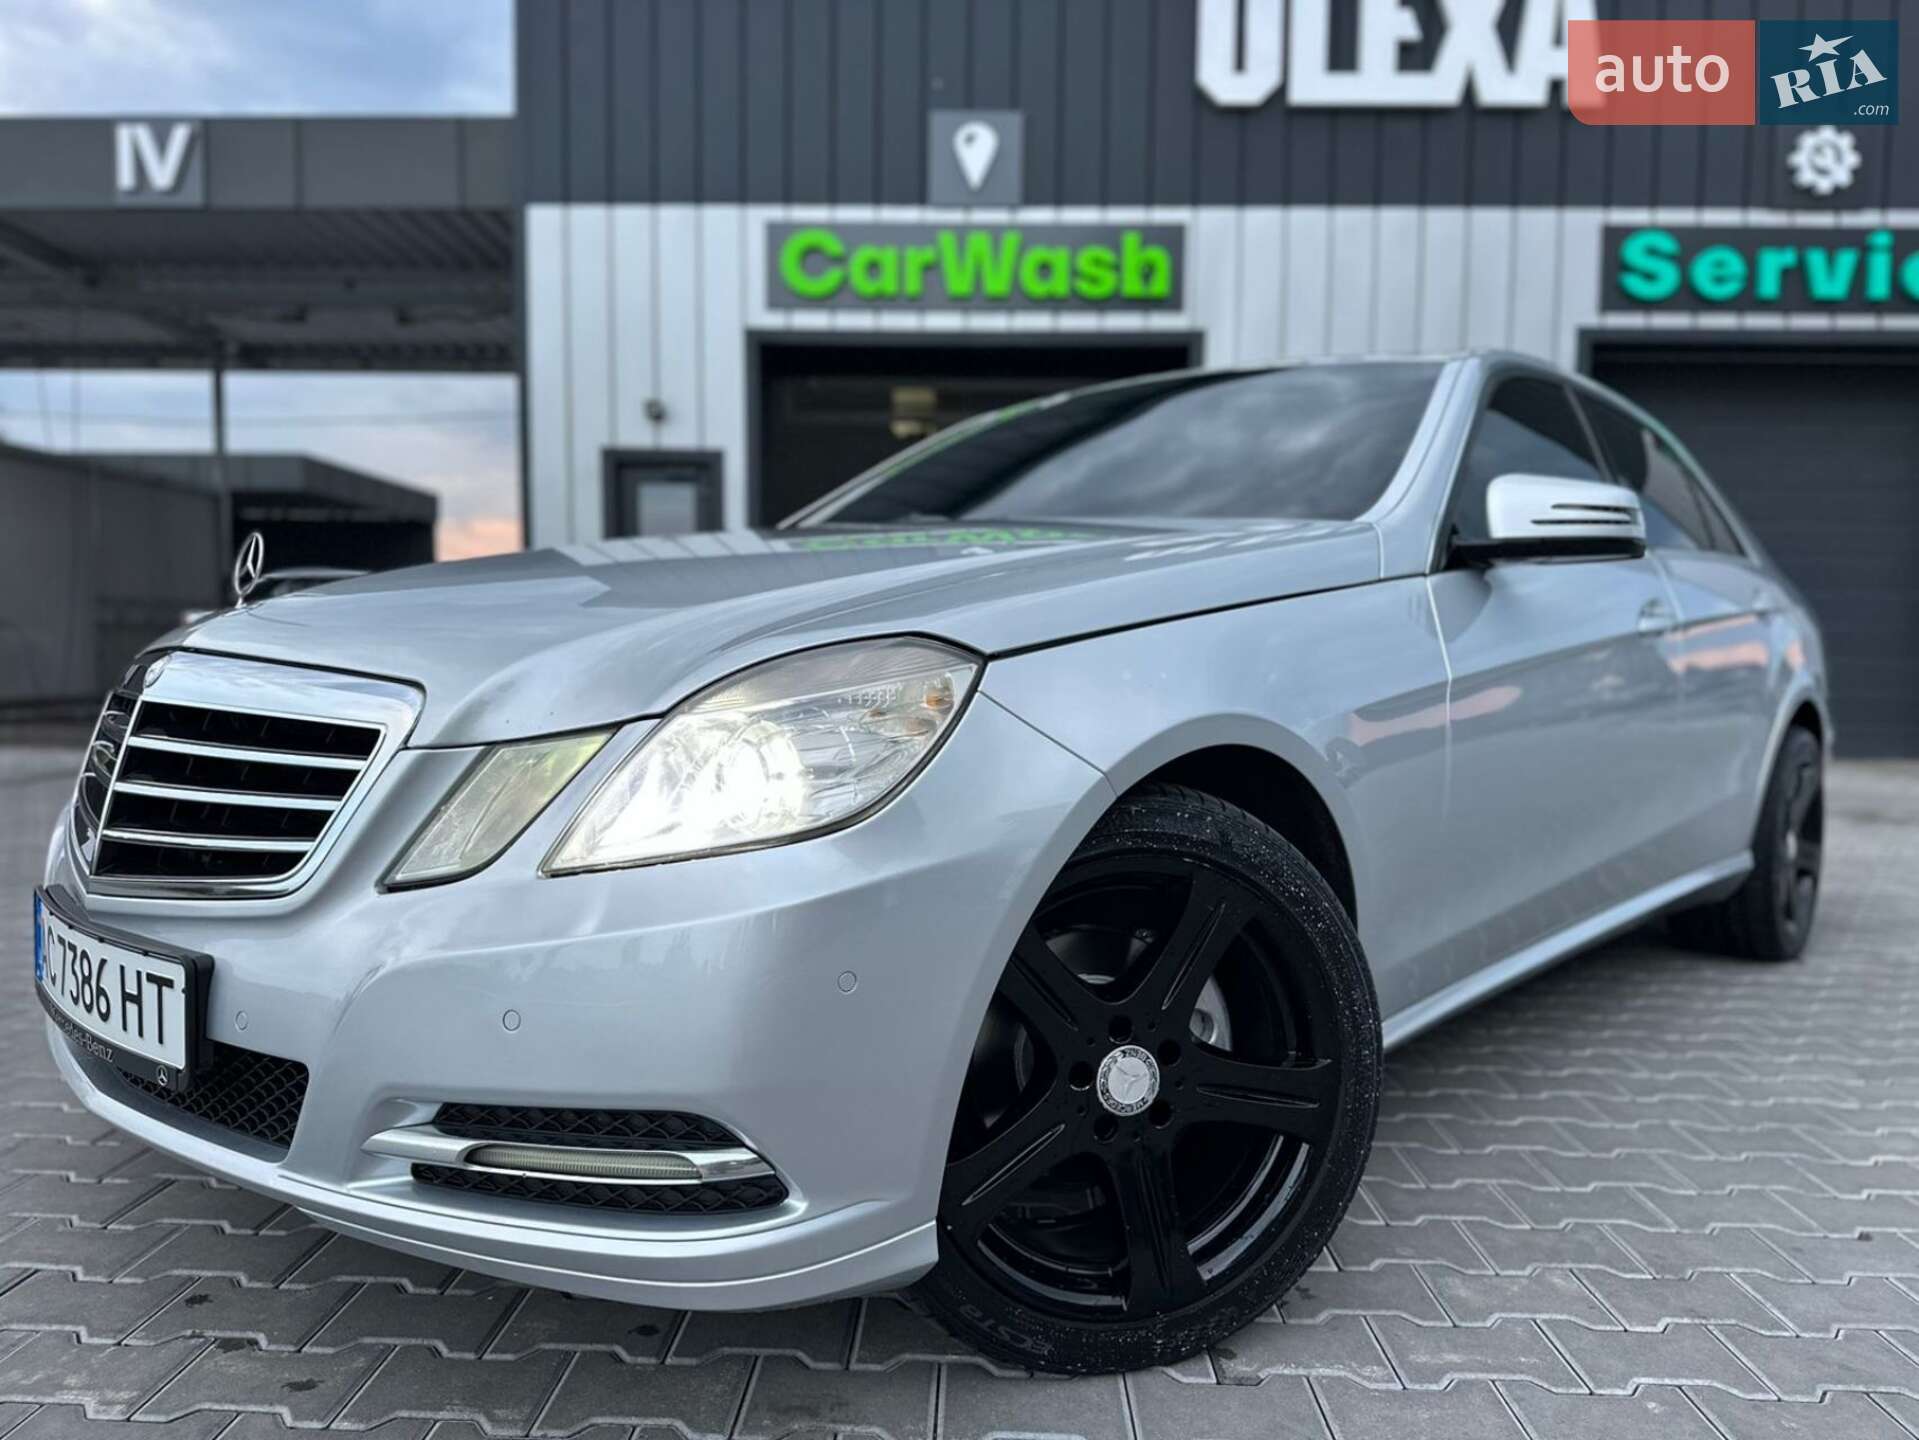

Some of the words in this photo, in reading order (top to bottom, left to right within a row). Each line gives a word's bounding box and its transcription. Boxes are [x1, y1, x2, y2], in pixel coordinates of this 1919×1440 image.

[116, 122, 192, 191] IV
[779, 229, 1173, 299] CarWash
[119, 964, 174, 1045] HT
